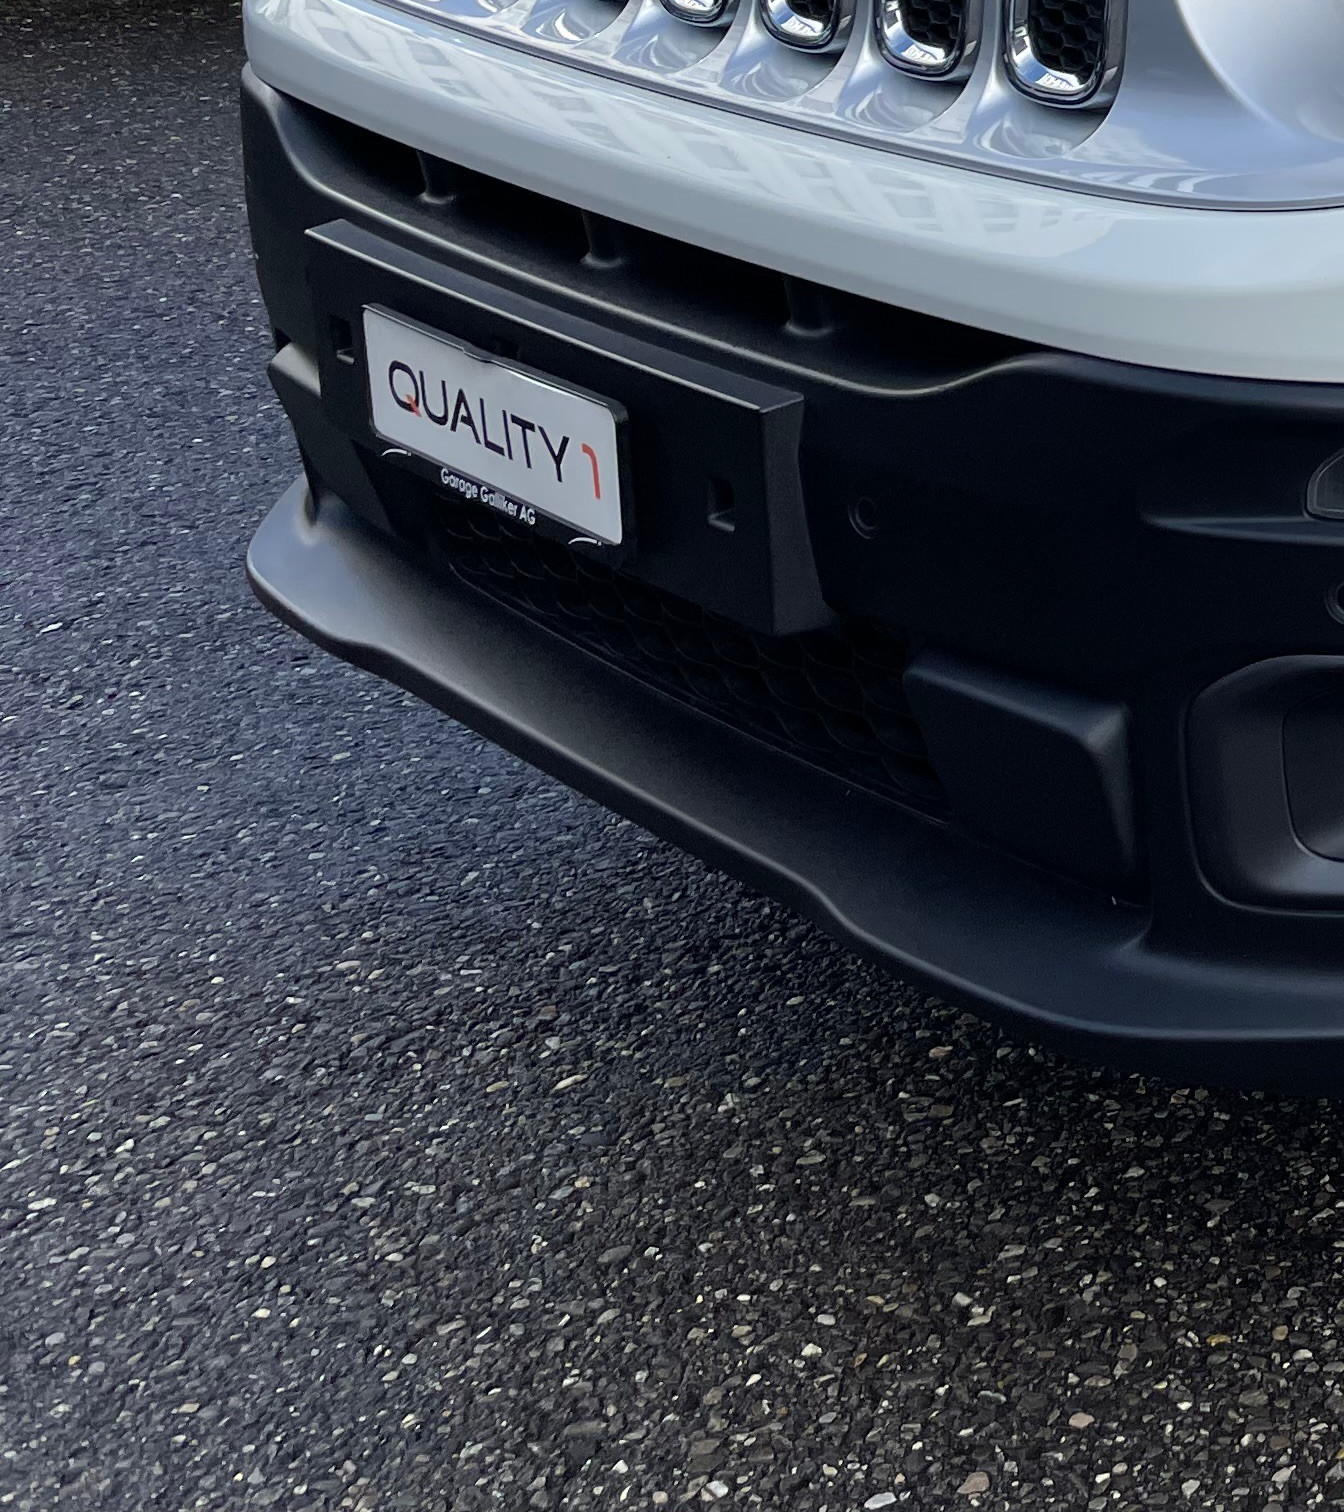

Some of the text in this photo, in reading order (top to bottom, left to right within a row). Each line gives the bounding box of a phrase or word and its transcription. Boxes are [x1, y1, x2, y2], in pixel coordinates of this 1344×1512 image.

[389, 361, 570, 483] QUALITY
[440, 467, 537, 526] Garage Galliker AG
